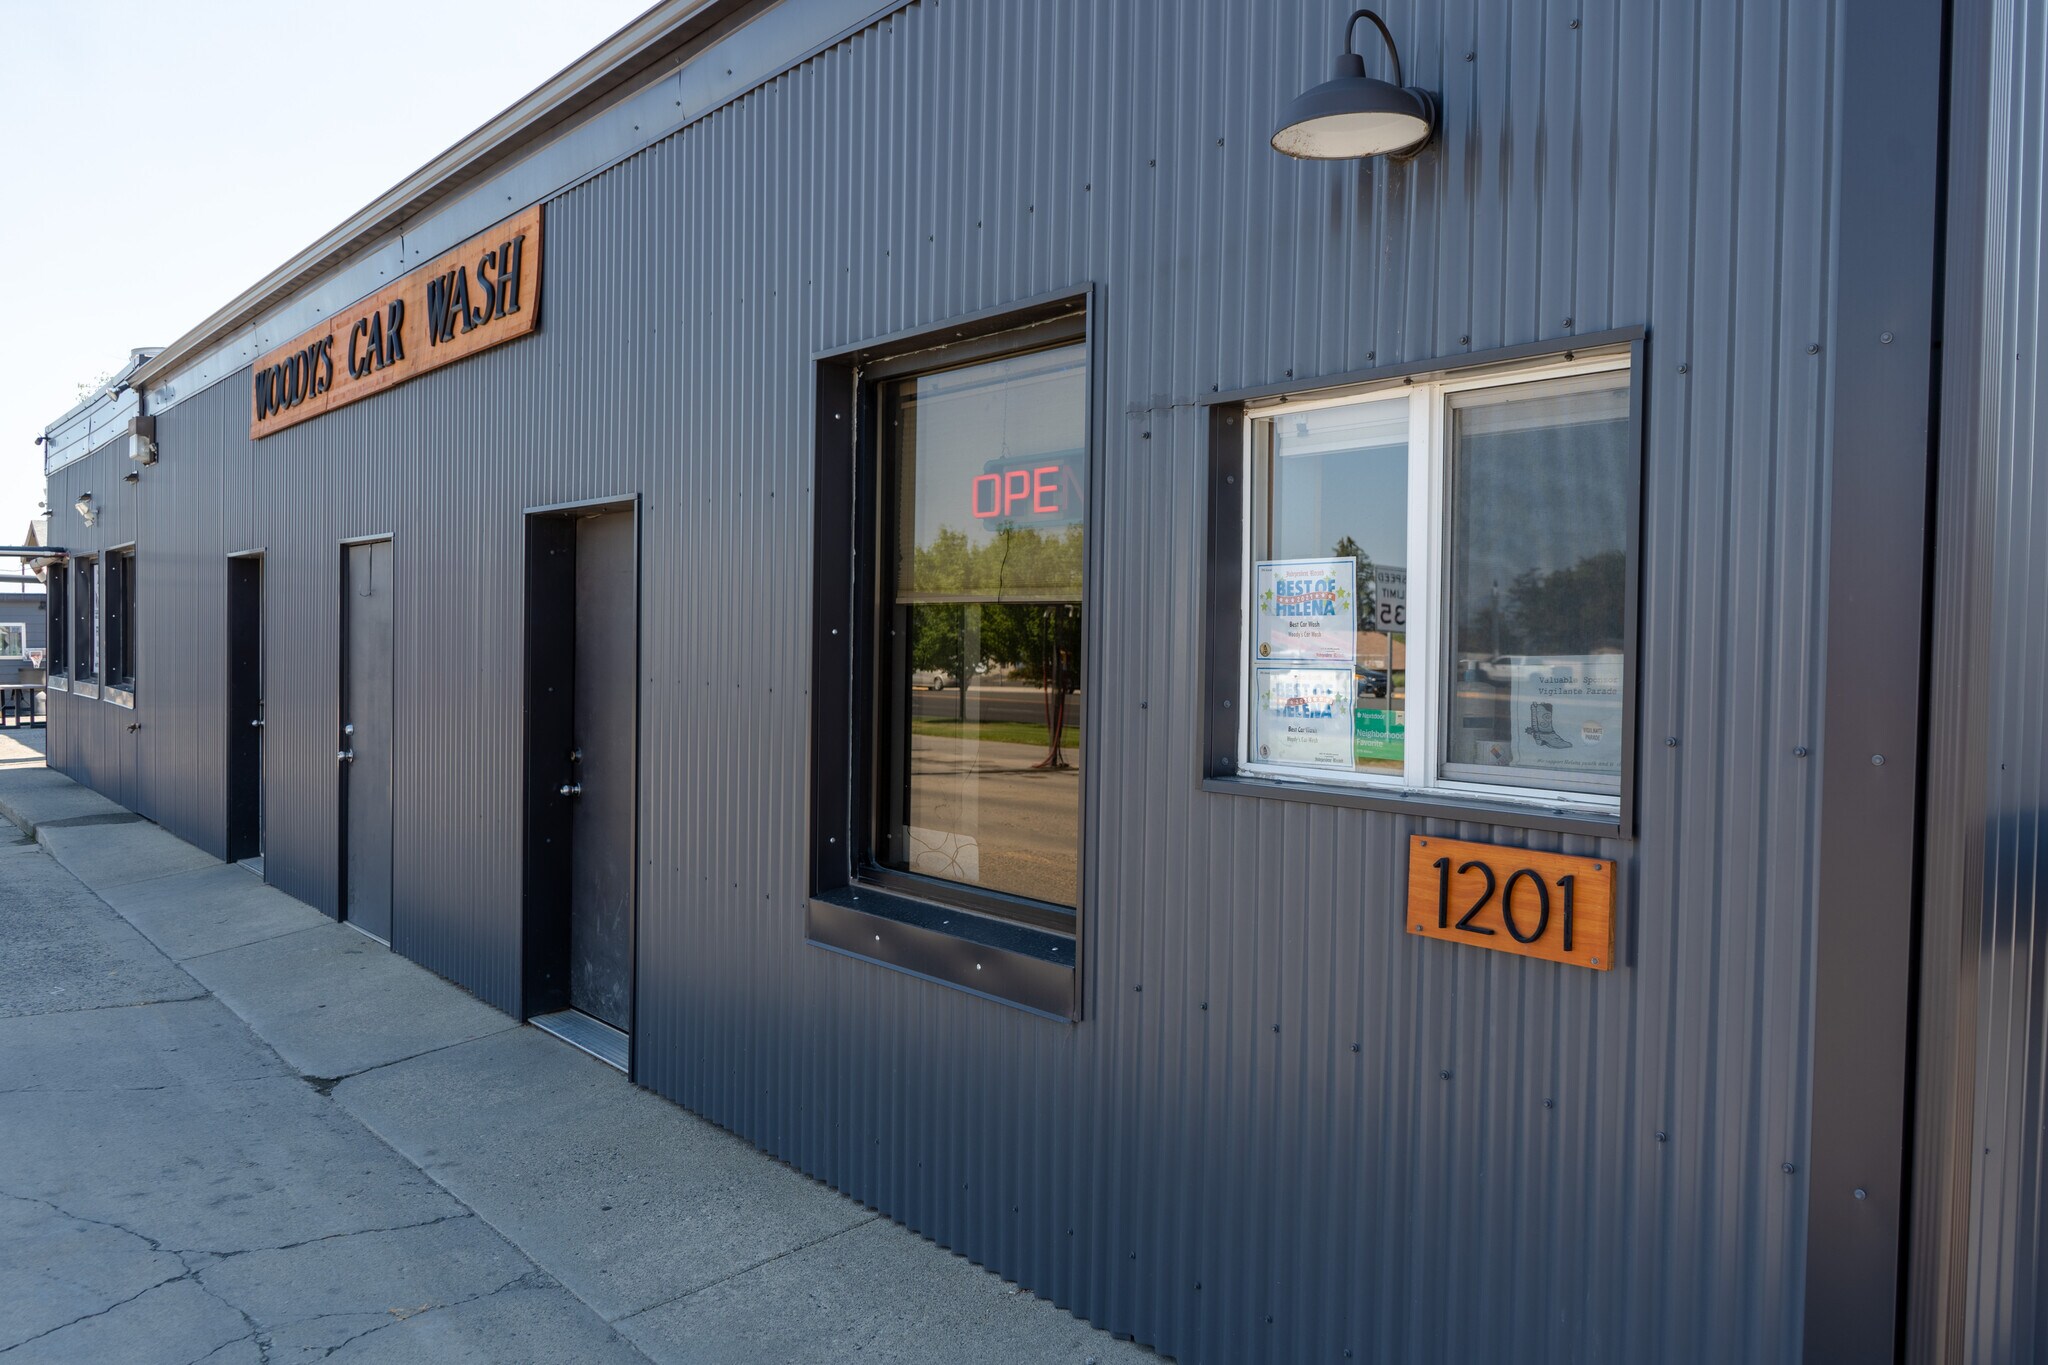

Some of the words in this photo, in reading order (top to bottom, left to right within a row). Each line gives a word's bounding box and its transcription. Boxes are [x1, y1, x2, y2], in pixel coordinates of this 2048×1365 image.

[255, 334, 334, 422] WOODYS
[348, 298, 405, 380] CAR
[427, 235, 526, 347] WASH
[1276, 579, 1312, 596] BEST
[1314, 579, 1336, 593] OF
[1296, 594, 1313, 602] 2021
[1276, 600, 1336, 616] HELENA
[1538, 688, 1583, 696] Vigilante
[1356, 738, 1383, 748] Favorite
[1433, 857, 1574, 952] 1201
